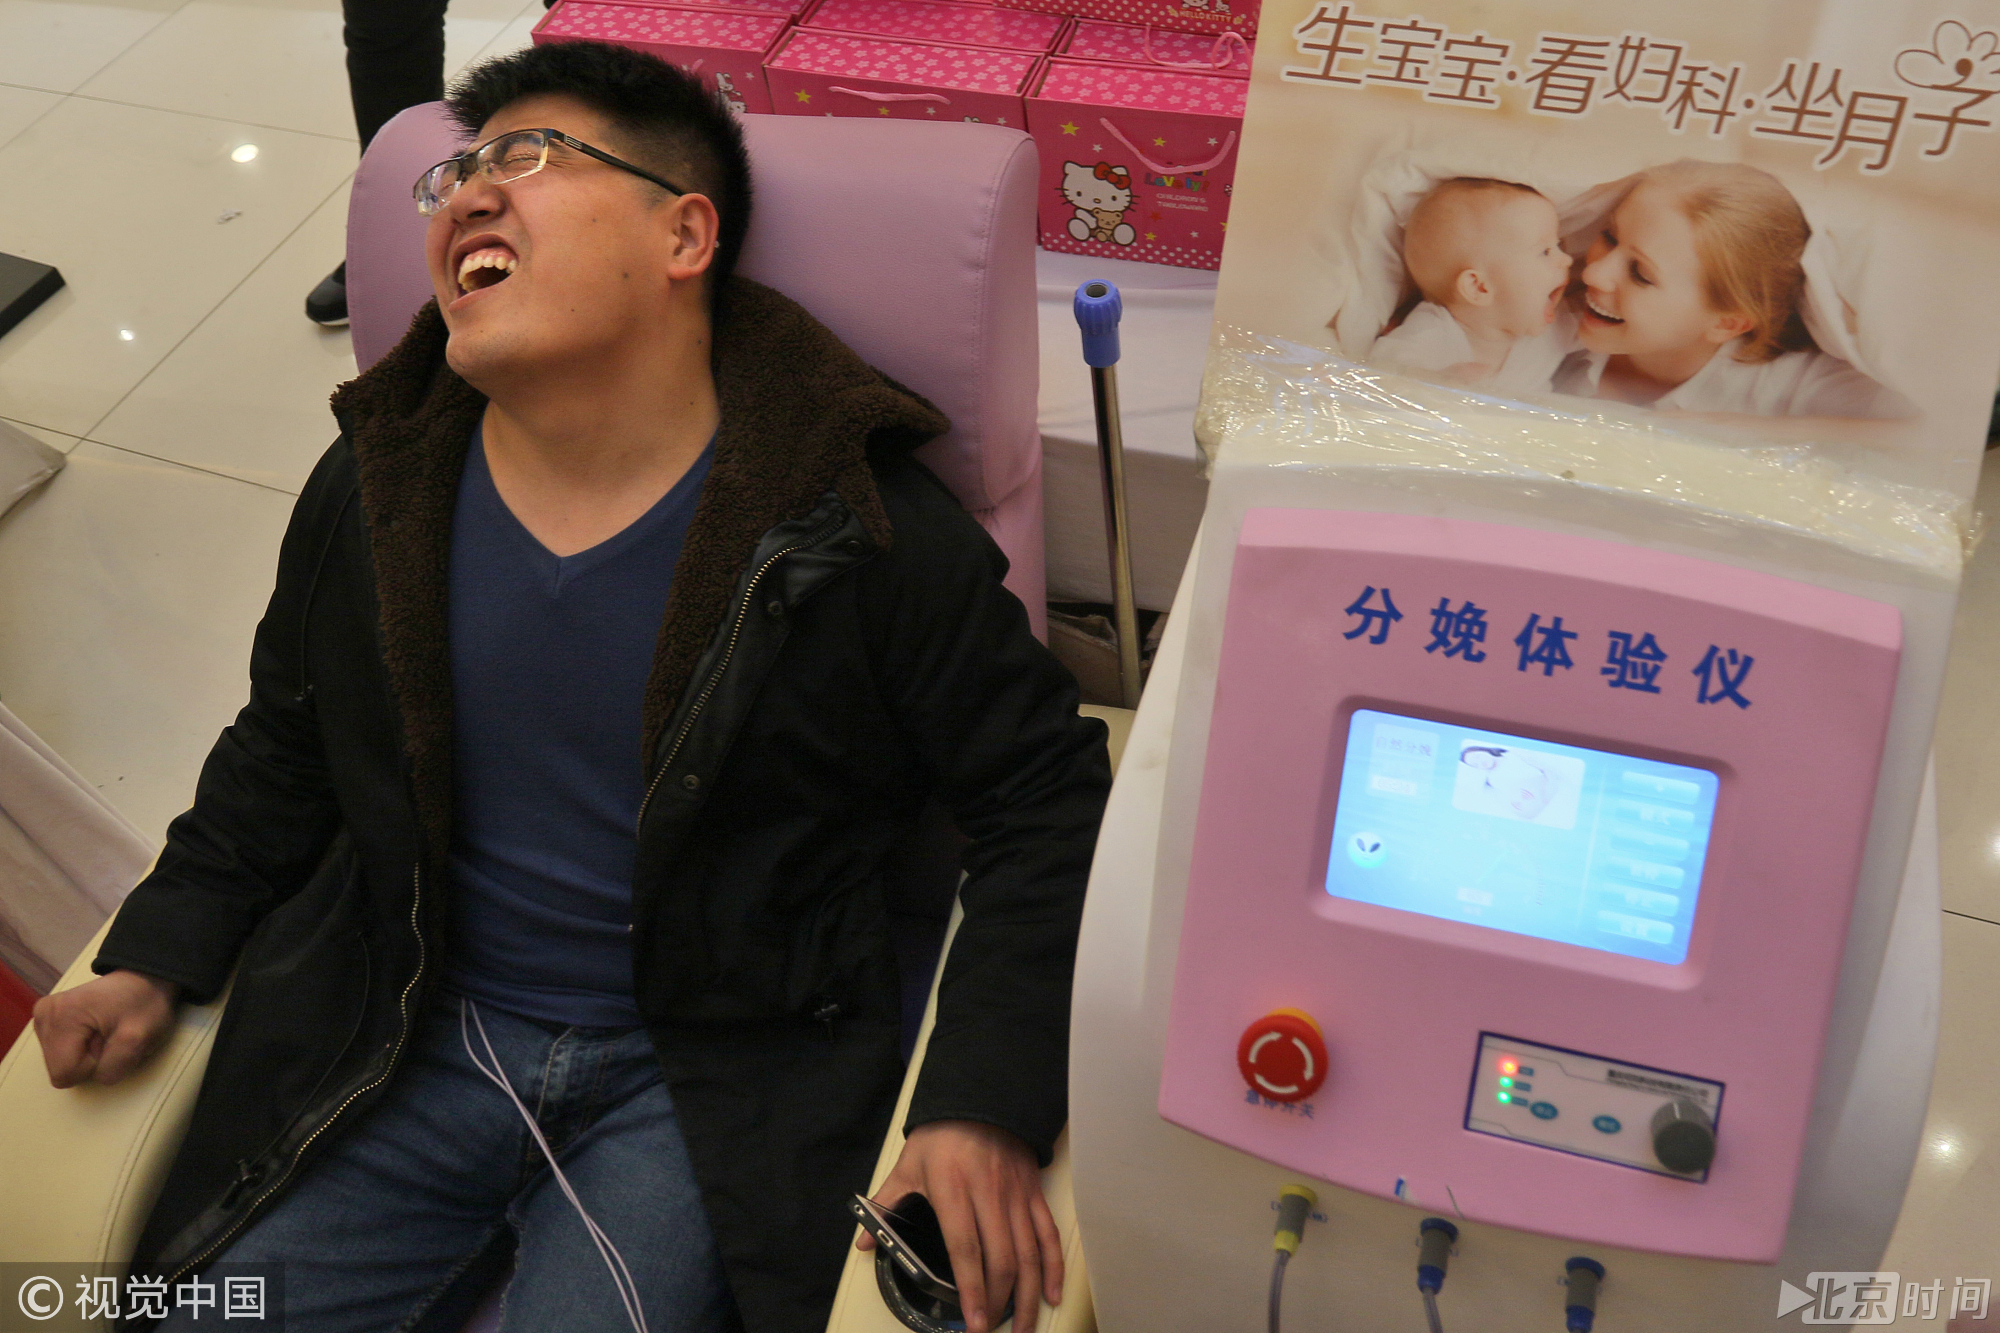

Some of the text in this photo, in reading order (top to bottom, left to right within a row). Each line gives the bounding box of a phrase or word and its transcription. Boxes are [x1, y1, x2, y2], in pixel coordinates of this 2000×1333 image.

[1342, 585, 1755, 710] 分娩体验仪
